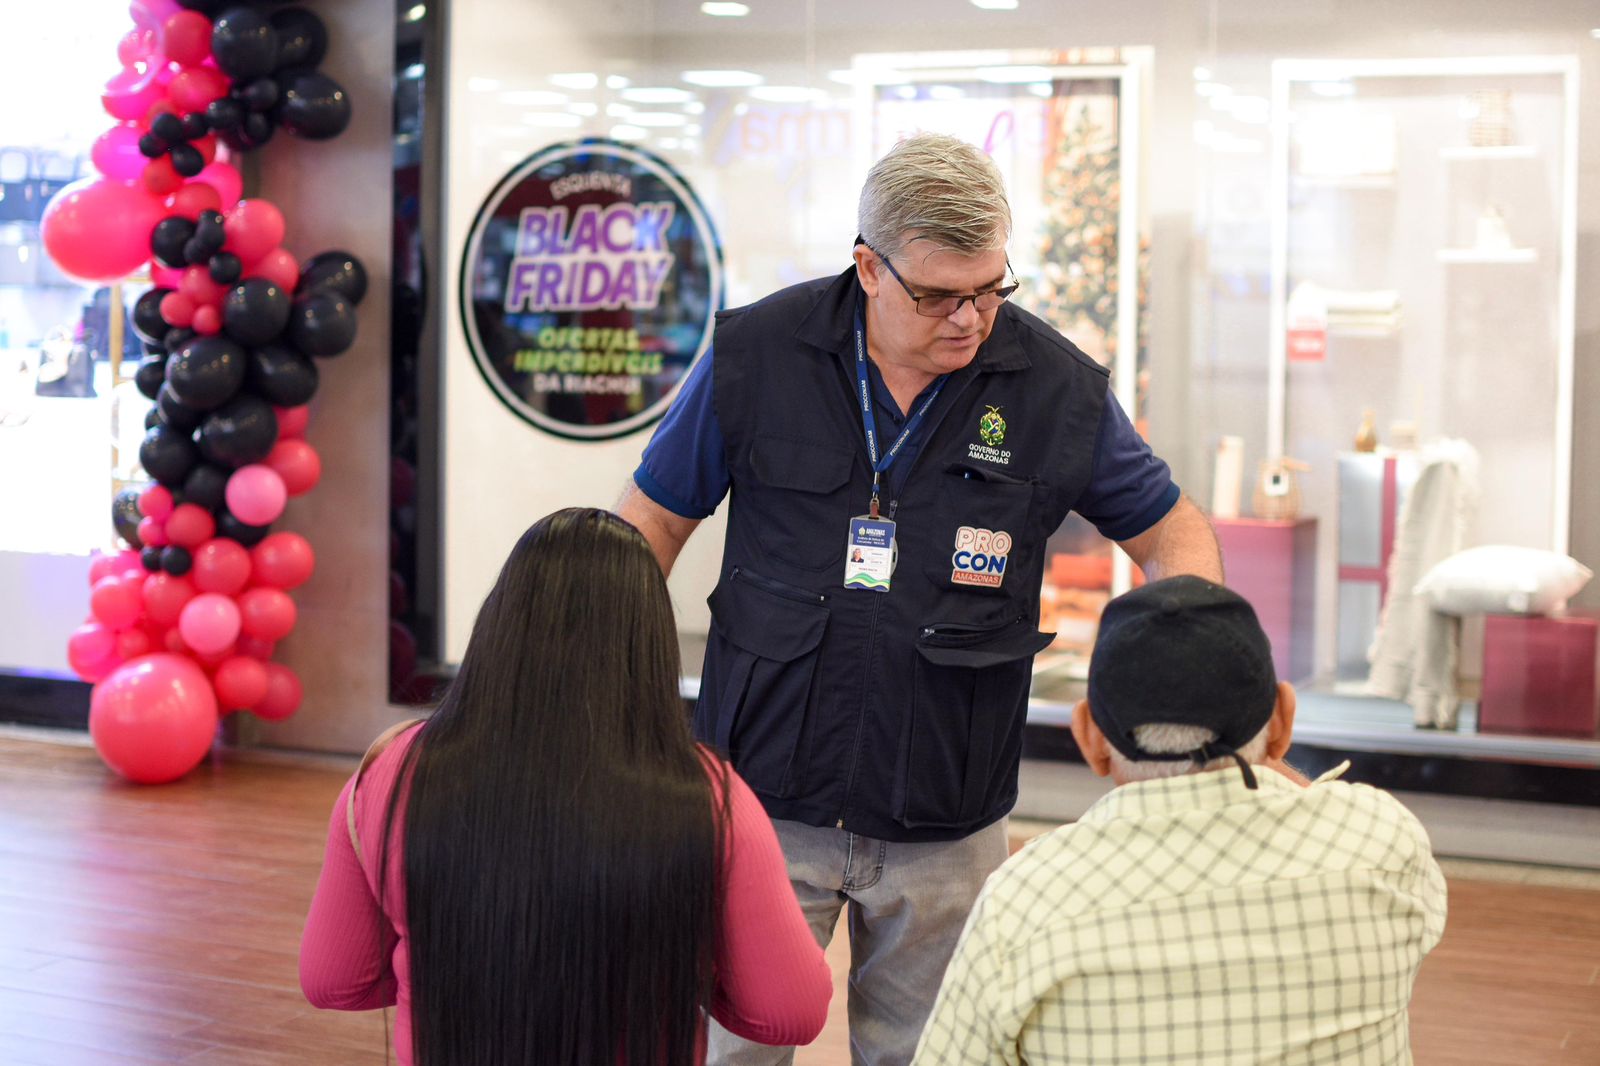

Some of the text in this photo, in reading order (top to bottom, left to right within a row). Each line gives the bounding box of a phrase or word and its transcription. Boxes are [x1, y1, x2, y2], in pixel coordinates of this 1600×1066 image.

[550, 171, 632, 201] ESQUENTA
[516, 204, 674, 257] BLACK
[506, 256, 673, 311] FRIDAY
[537, 327, 639, 350] OFERTAS
[533, 373, 561, 393] DA
[968, 443, 1011, 458] GOVERNO DO
[968, 450, 1009, 464] AMAZONAS
[956, 527, 1011, 555] PRO
[954, 551, 1006, 573] CON
[954, 572, 1000, 584] AMAZONAS
